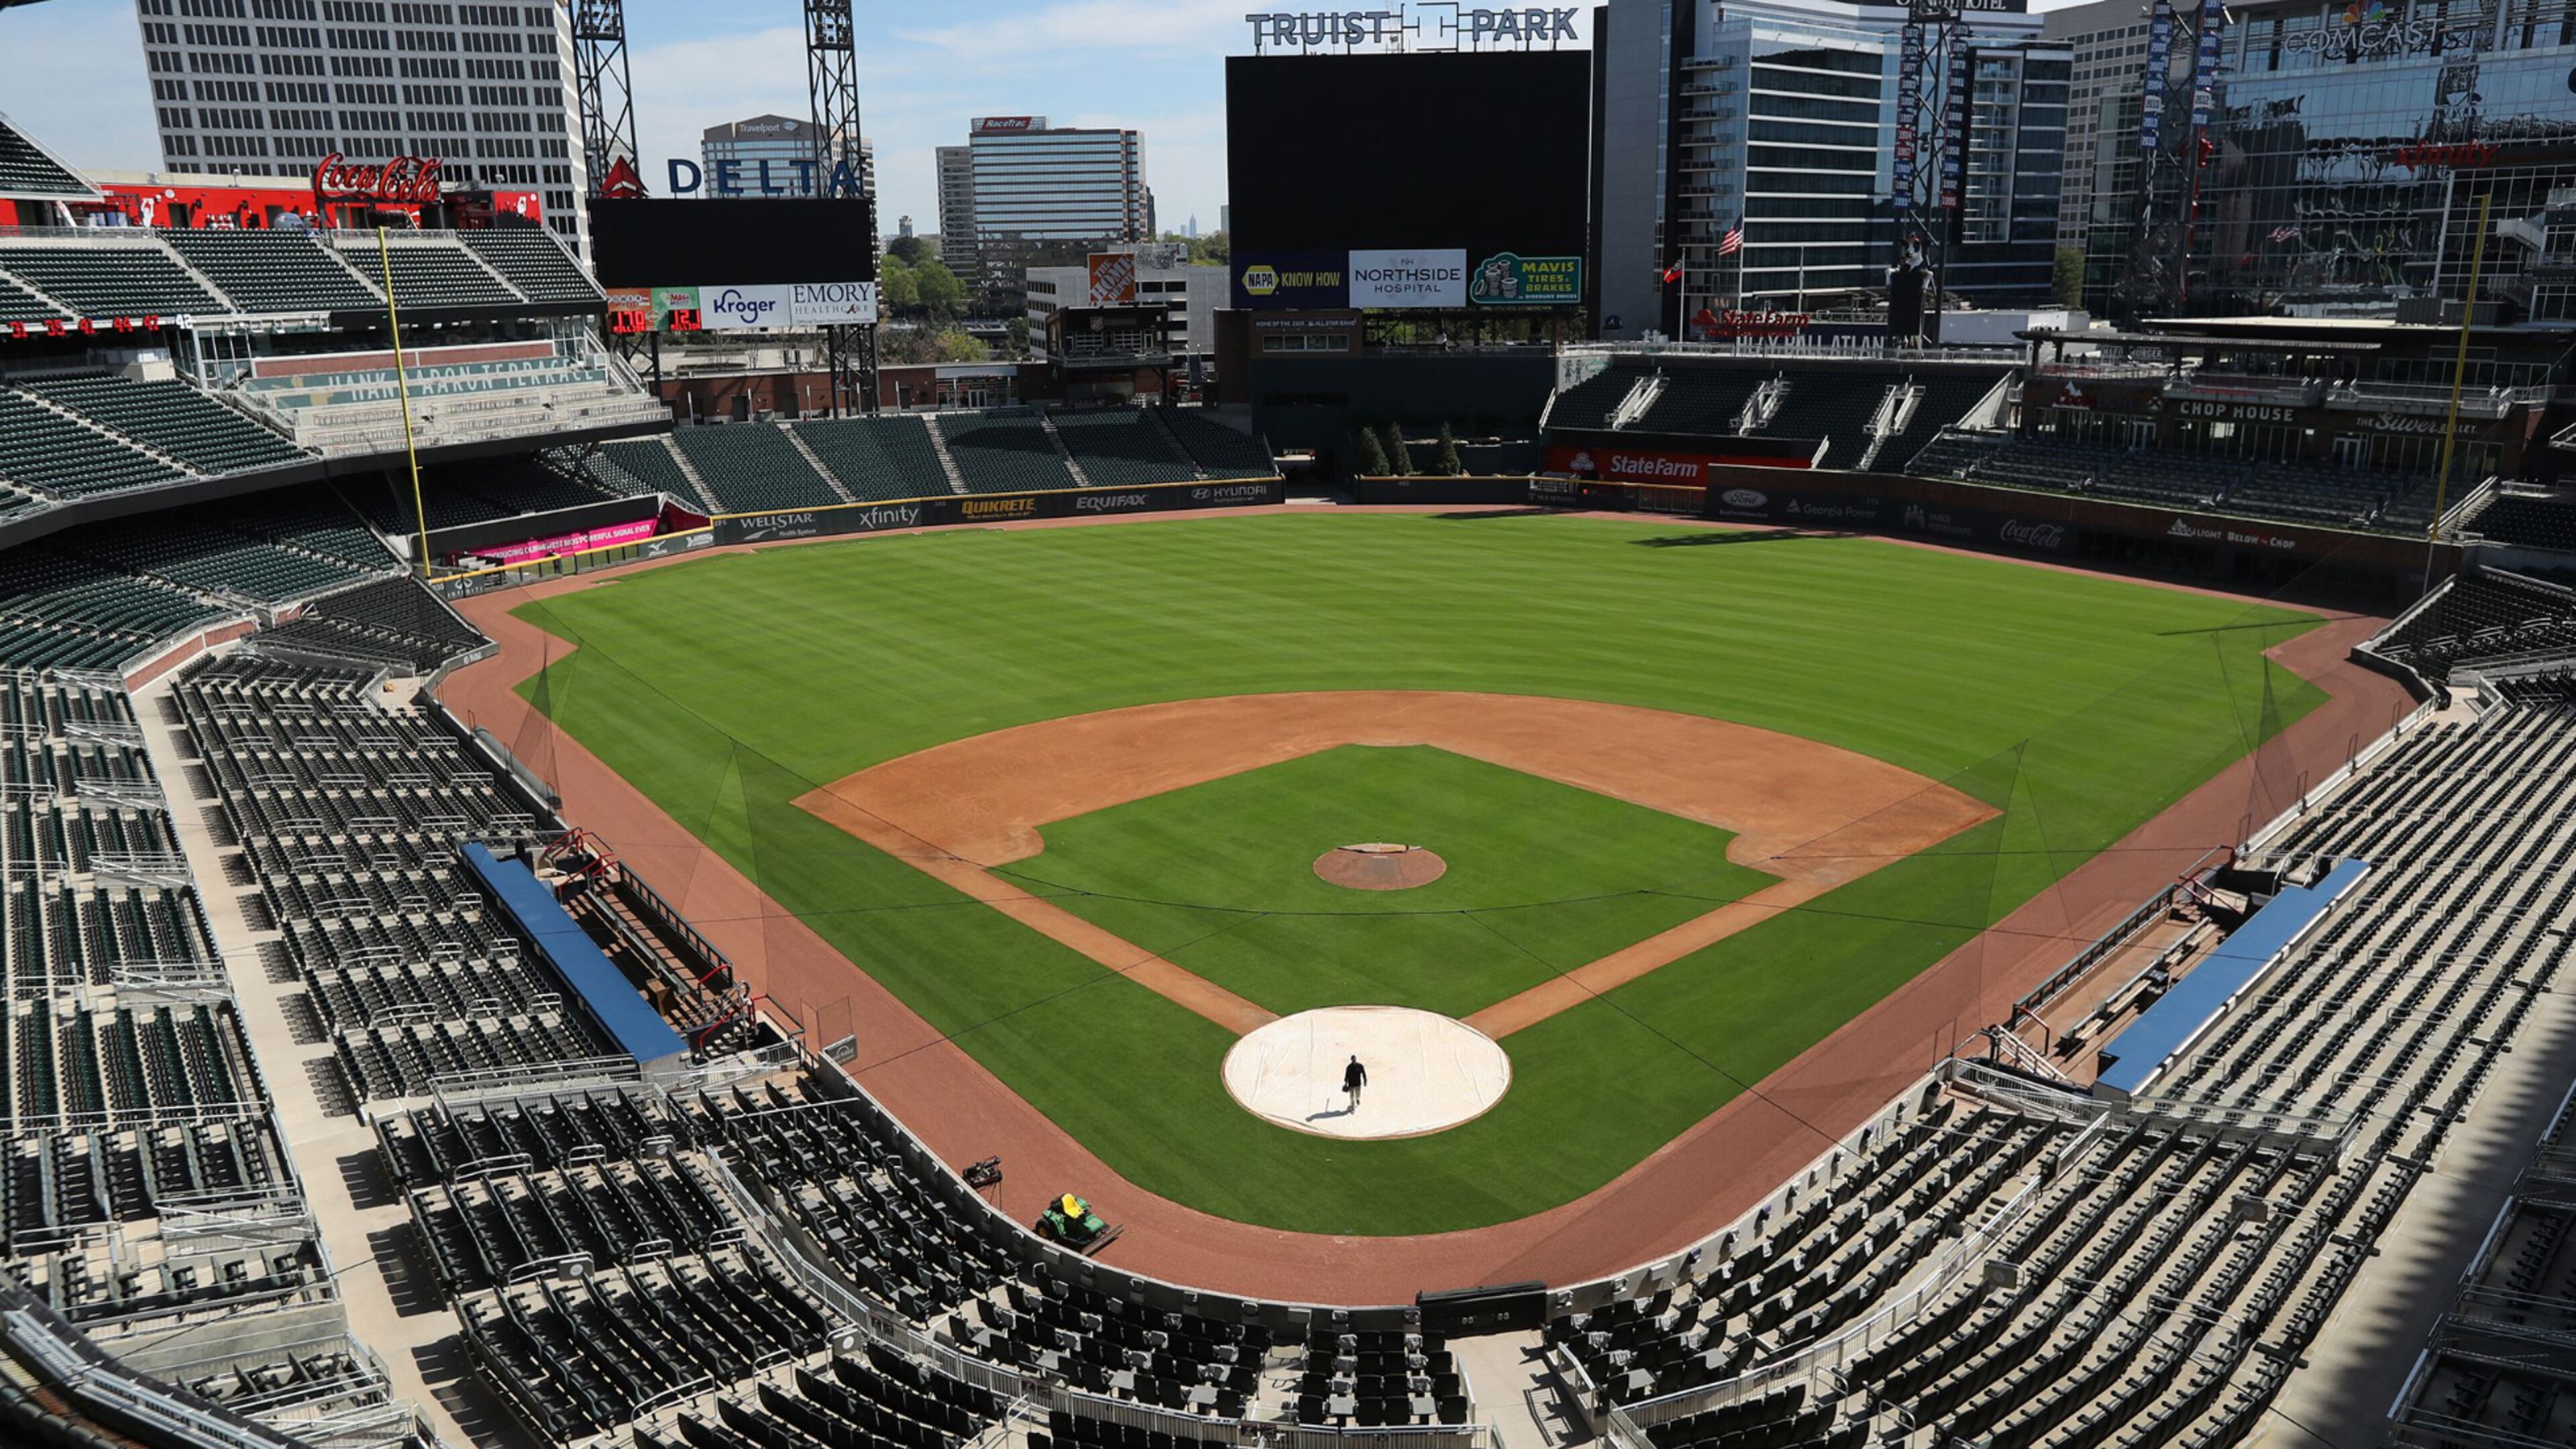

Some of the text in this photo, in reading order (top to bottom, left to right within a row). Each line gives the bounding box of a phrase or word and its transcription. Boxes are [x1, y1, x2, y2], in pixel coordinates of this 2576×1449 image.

[1246, 8, 1578, 46] TRUIST PARK
[2202, 37, 2216, 46] 2001
[2285, 19, 2442, 55] COMCAST
[2195, 95, 2210, 105] 2012
[739, 123, 781, 133] Travelport
[985, 118, 1027, 129] RaceTrac
[2394, 138, 2500, 172] xfinity
[667, 158, 861, 194] DELTA
[1095, 259, 1112, 278] THE
[1355, 268, 1461, 282] NORTHSIDE
[1522, 262, 1575, 272] MAVIS
[1090, 254, 1136, 301] HOME
[1248, 272, 1340, 288] NAPA KNOW HOW
[1528, 274, 1564, 282] TIRES
[794, 284, 871, 303] EMORY
[1108, 271, 1134, 301] DEPOT
[1375, 285, 1442, 293] HOSPITAL
[1526, 284, 1572, 292] BRAKES
[714, 289, 775, 323] Kroger
[795, 304, 869, 315] HEALTHCARE
[78, 318, 95, 334] 41
[113, 316, 133, 333] 44
[143, 315, 159, 331] 47
[174, 313, 193, 329] 42
[617, 311, 645, 326] 170
[9, 321, 28, 338] 31
[43, 319, 66, 336] 35
[613, 325, 646, 333] MILLION
[671, 323, 701, 331] MILLION
[329, 357, 594, 401] HANK AARON TERRACE
[2180, 402, 2294, 423] CHOP HOUSE
[2357, 417, 2375, 427] THE
[2375, 411, 2438, 433] Silver
[1214, 485, 1267, 497] HYUNDAI
[1730, 492, 1759, 504] Ford
[961, 498, 1036, 515] QUIKRETE
[1076, 494, 1147, 511] EQUIFAX
[859, 506, 919, 529] xfinity
[1803, 503, 1878, 519] Georgia Power
[741, 513, 813, 529] WELLSTAR
[613, 527, 635, 538] SIGNAL
[635, 524, 650, 534] EVER
[2197, 529, 2221, 539] LIGHT
[2227, 531, 2258, 544] BELOW
[2269, 536, 2295, 549] CHOP
[447, 586, 483, 598] INFINITI
